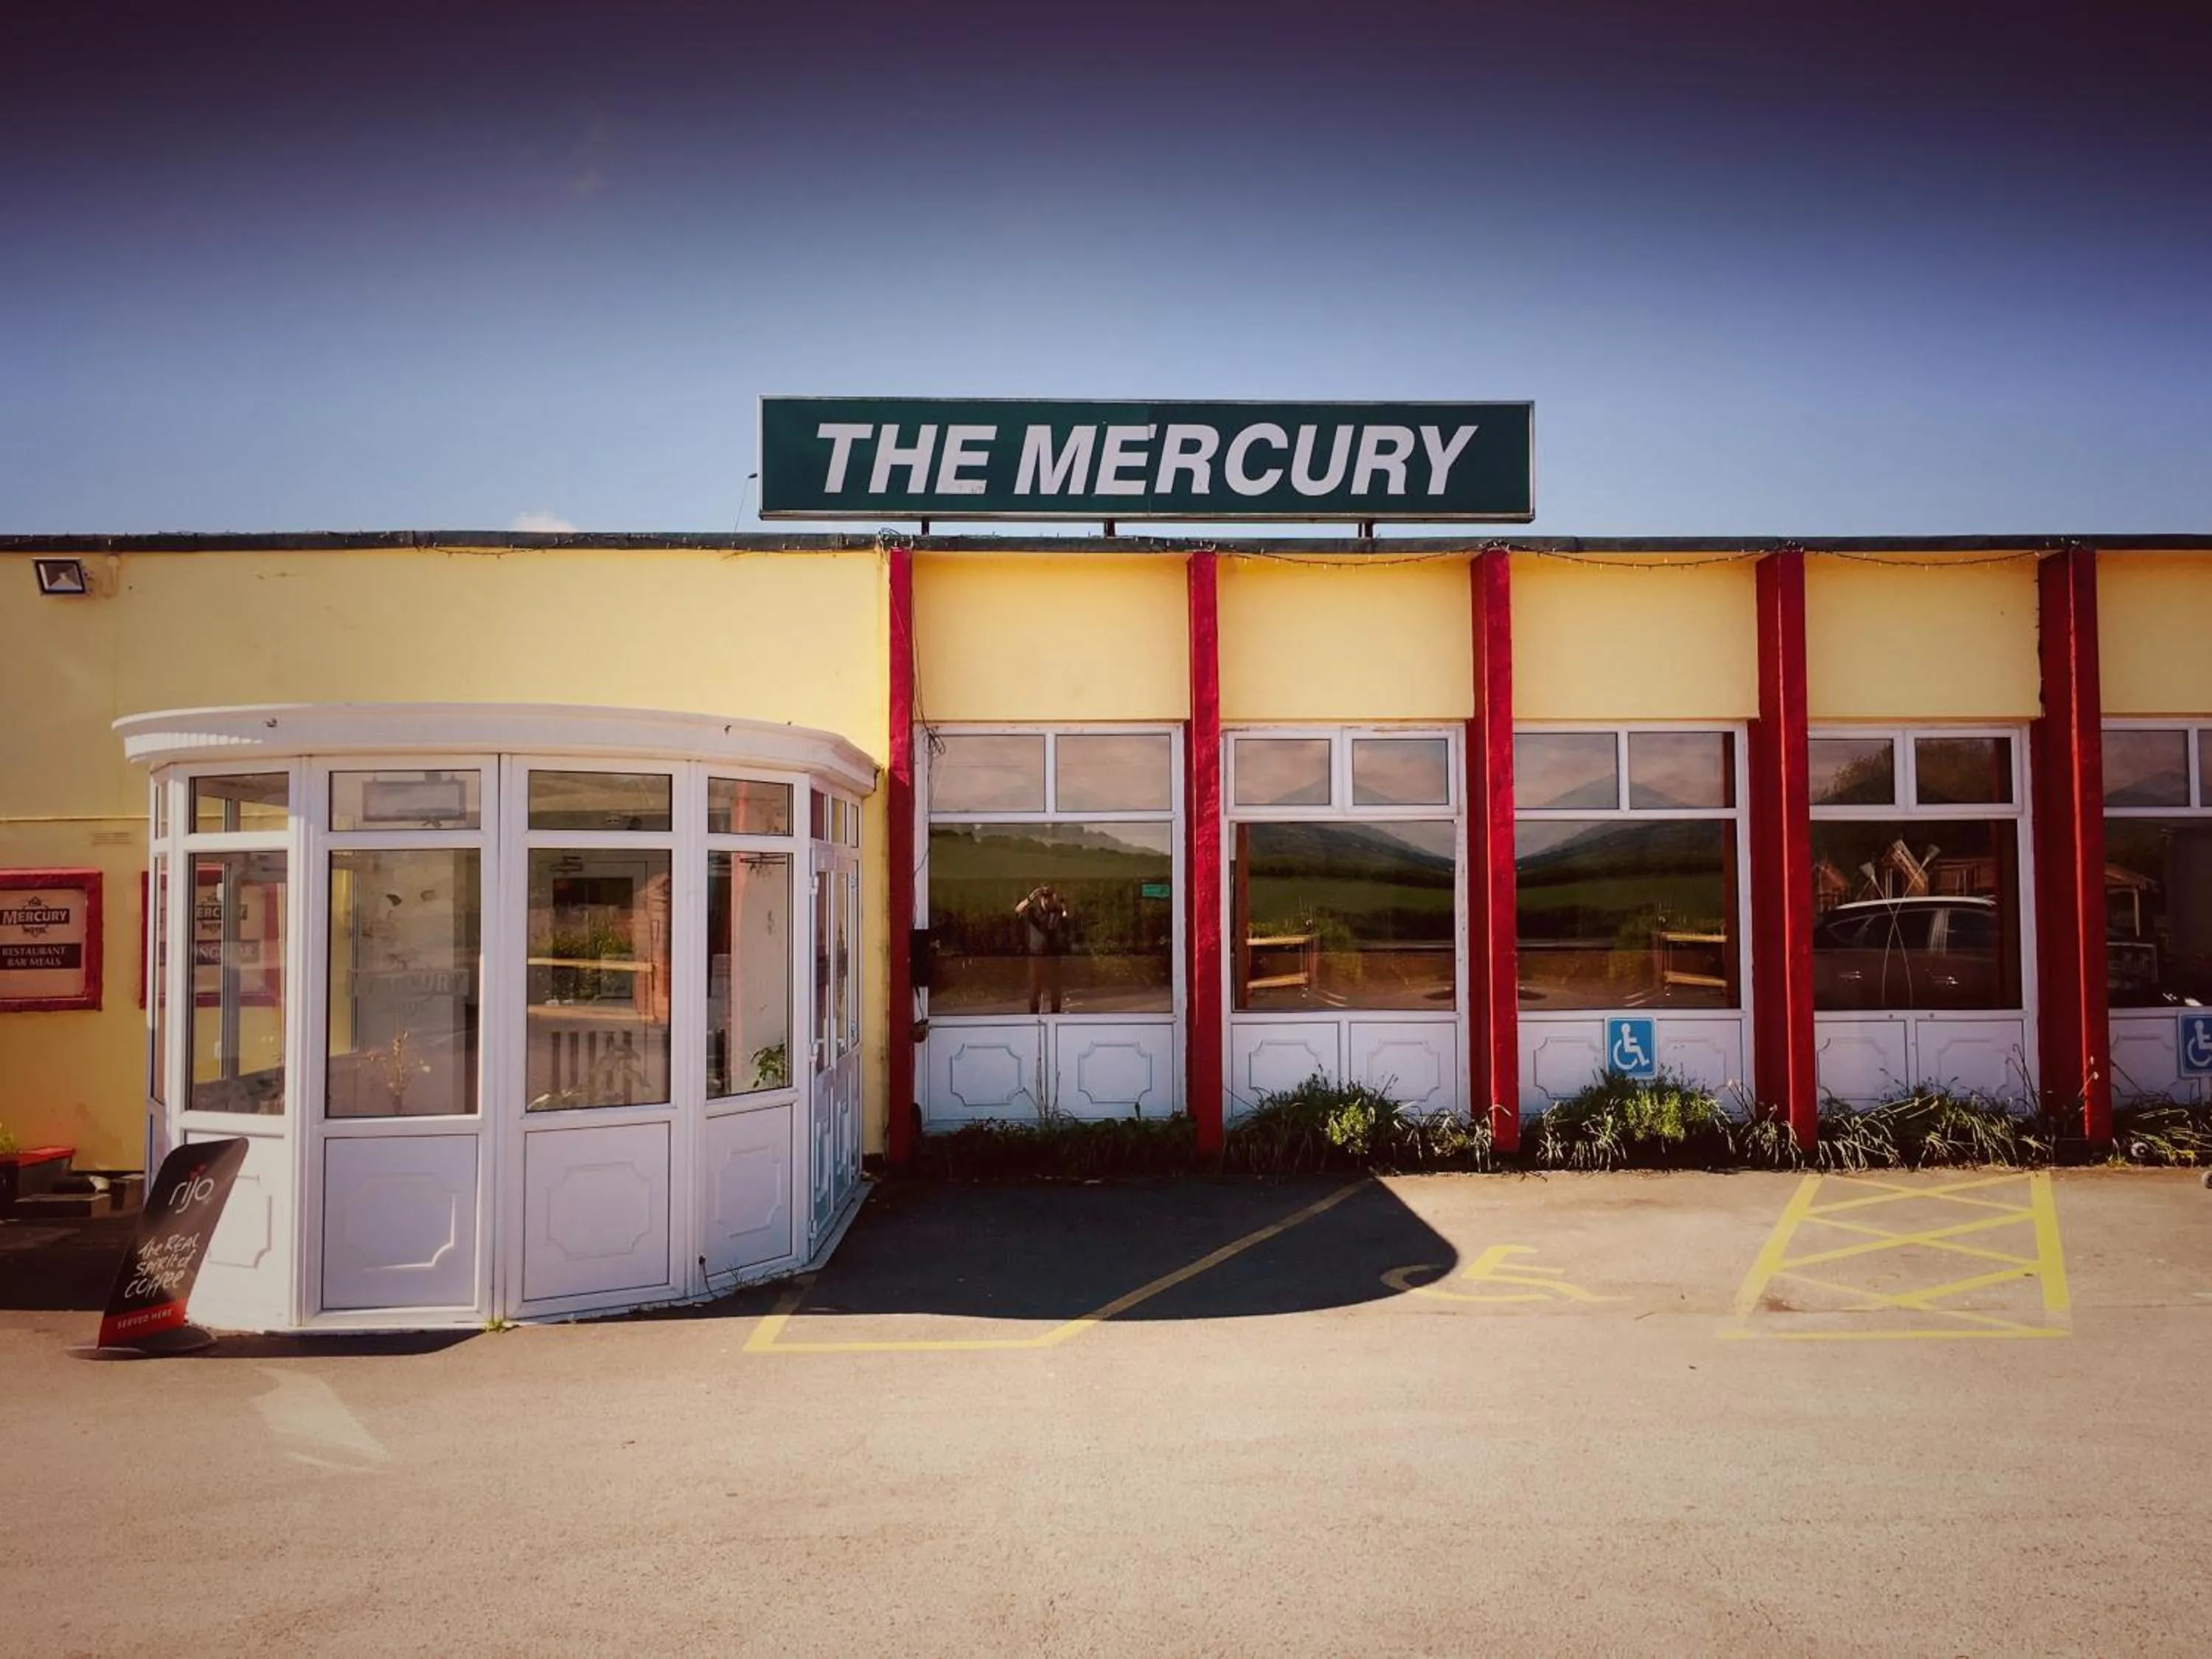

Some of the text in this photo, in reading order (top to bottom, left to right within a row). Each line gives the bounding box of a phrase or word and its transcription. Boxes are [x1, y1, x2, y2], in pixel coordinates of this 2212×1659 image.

[816, 422, 1478, 497] THE MERCURY
[2, 911, 68, 925] MERCURY
[2, 945, 66, 956] RESTAURANT
[7, 957, 61, 967] BAR MEALS
[116, 1309, 173, 1329] SERVED HERE
